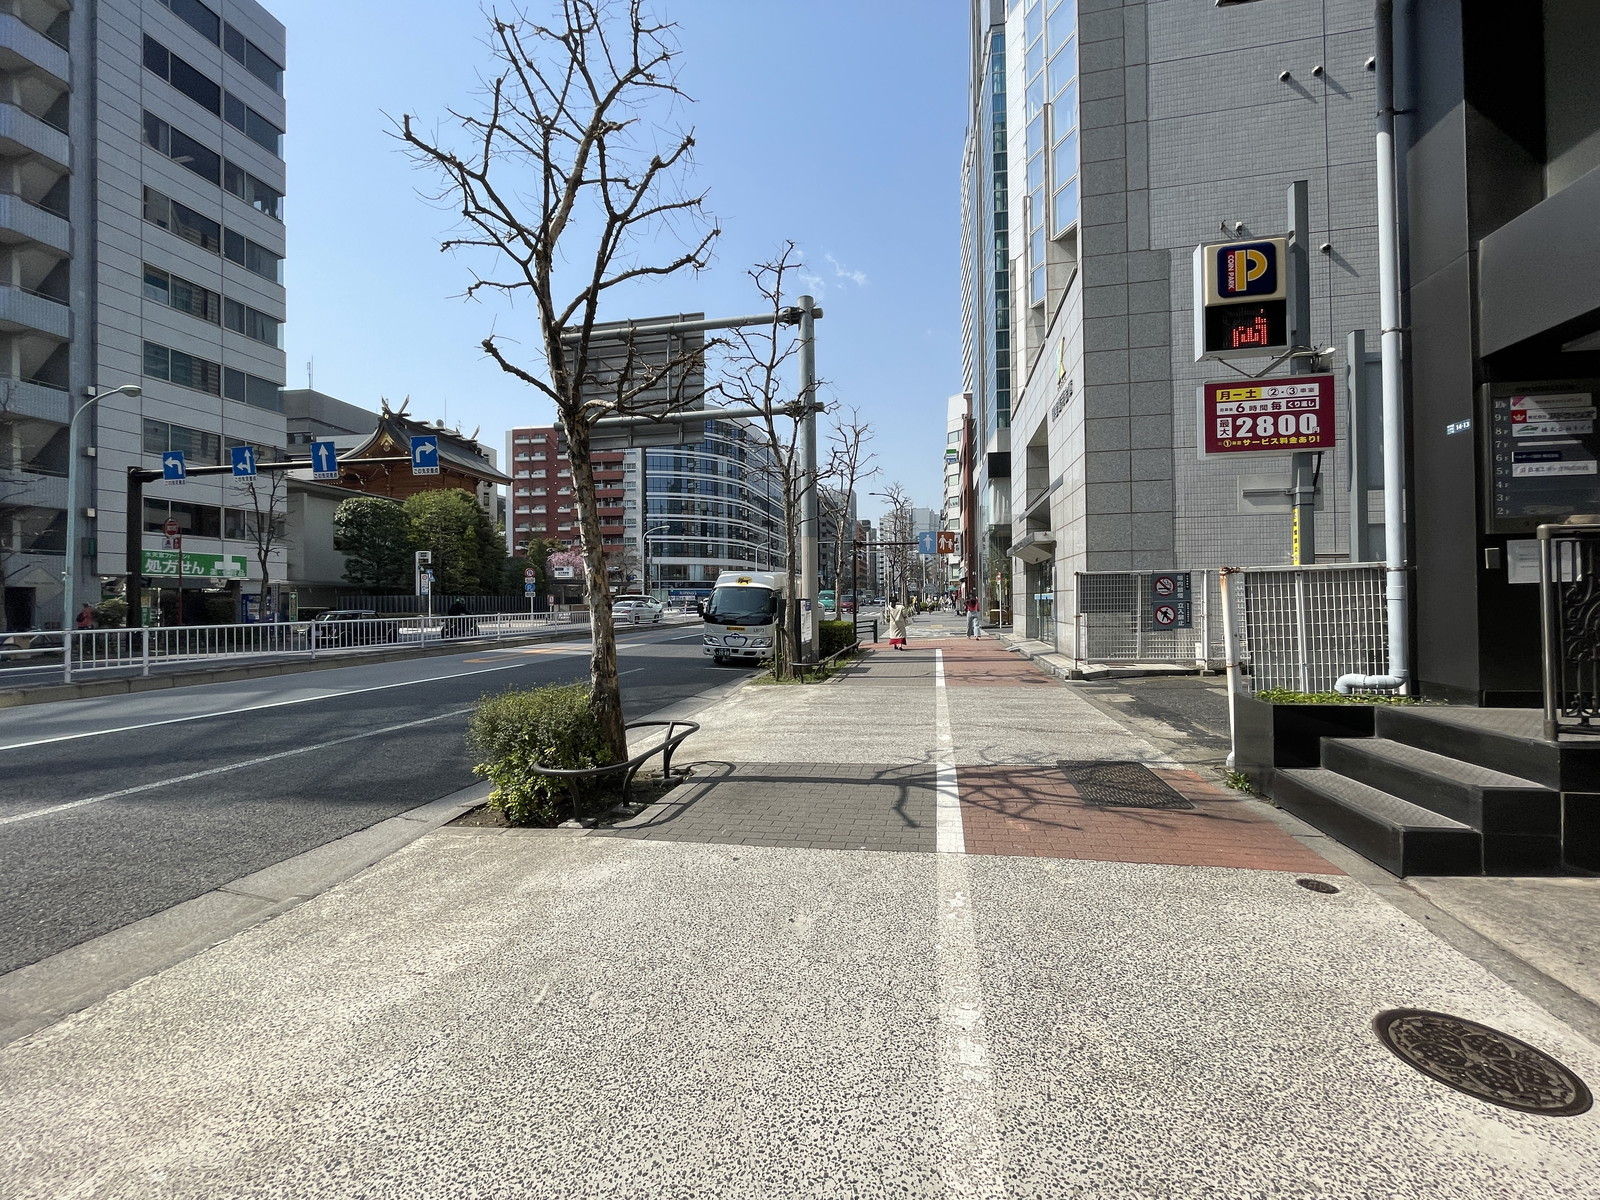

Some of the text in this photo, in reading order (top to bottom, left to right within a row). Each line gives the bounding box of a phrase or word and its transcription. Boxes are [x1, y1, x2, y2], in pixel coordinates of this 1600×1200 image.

[1220, 420, 1229, 436] 最大
[145, 559, 204, 574] 処方せん
